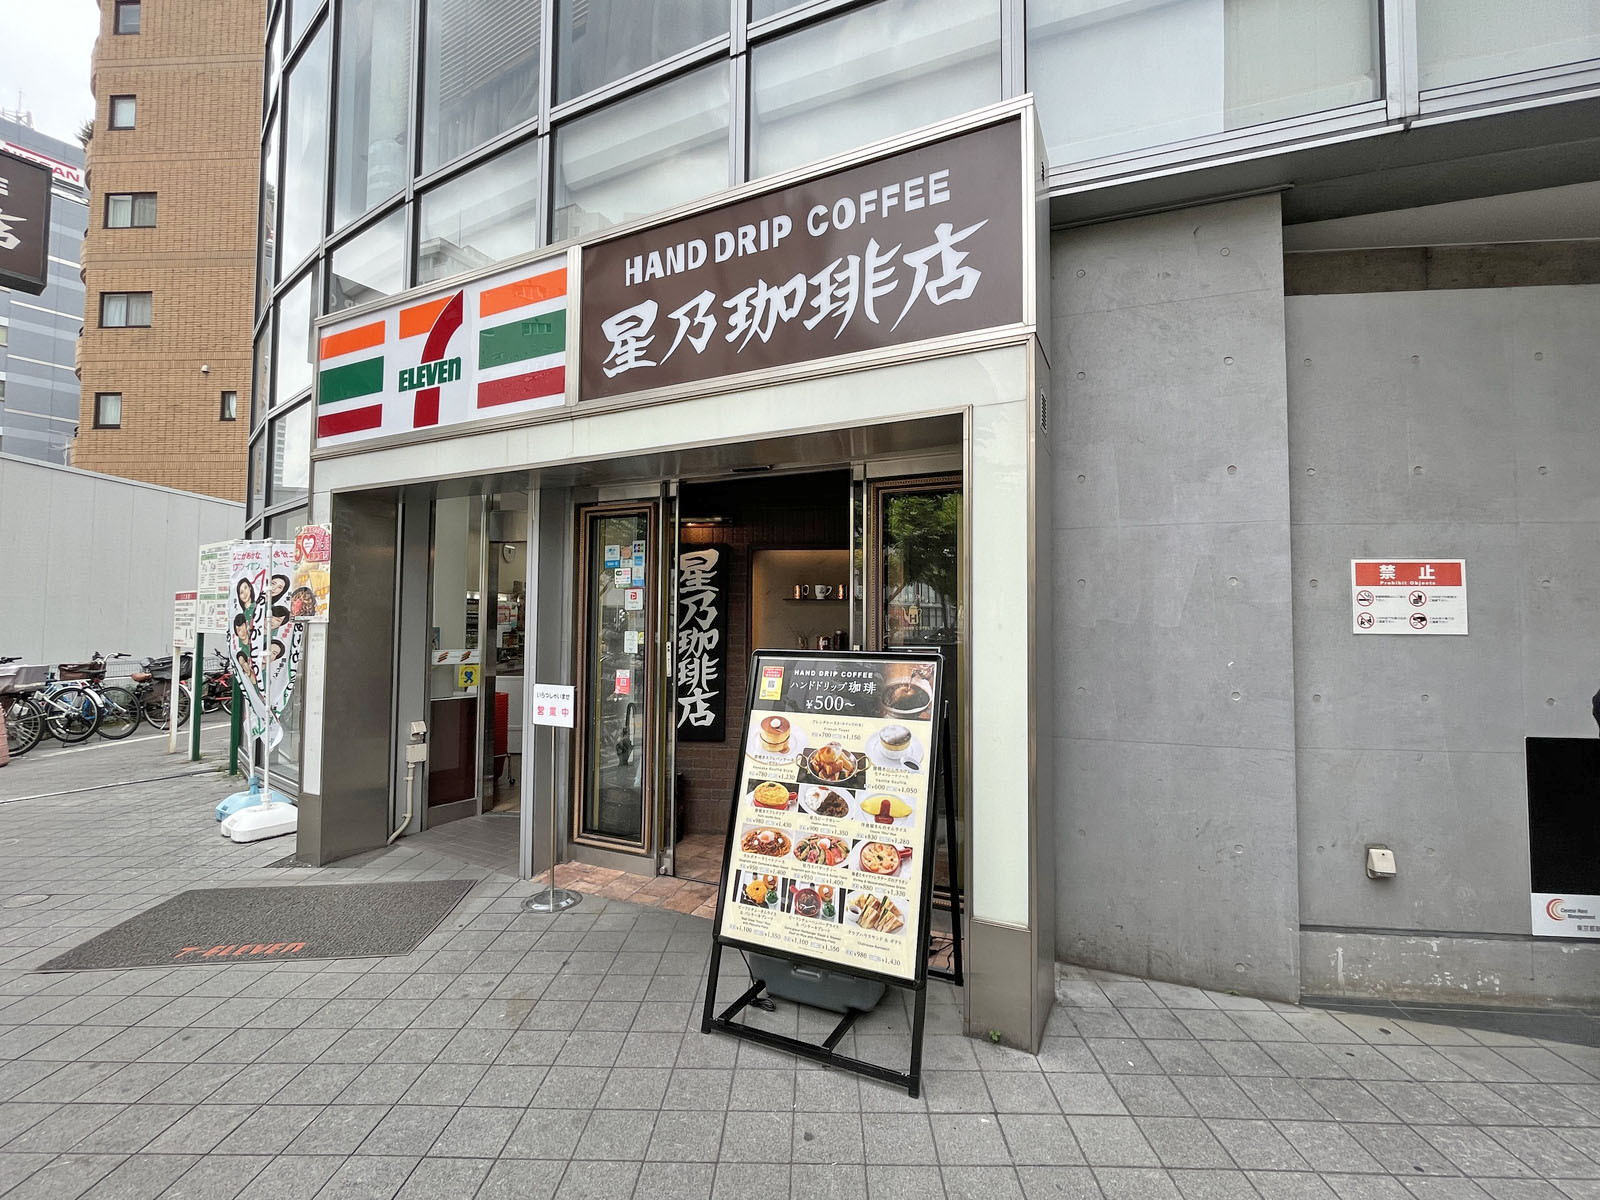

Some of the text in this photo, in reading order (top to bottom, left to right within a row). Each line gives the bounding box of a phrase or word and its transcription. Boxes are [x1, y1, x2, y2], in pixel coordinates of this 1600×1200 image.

[625, 168, 951, 287] HAND DRIP COFFEE
[600, 219, 989, 379] 星乃珈琲店
[1379, 564, 1436, 580] 禁止
[677, 548, 720, 729] 星乃珈琲店
[537, 705, 569, 717] 営業中
